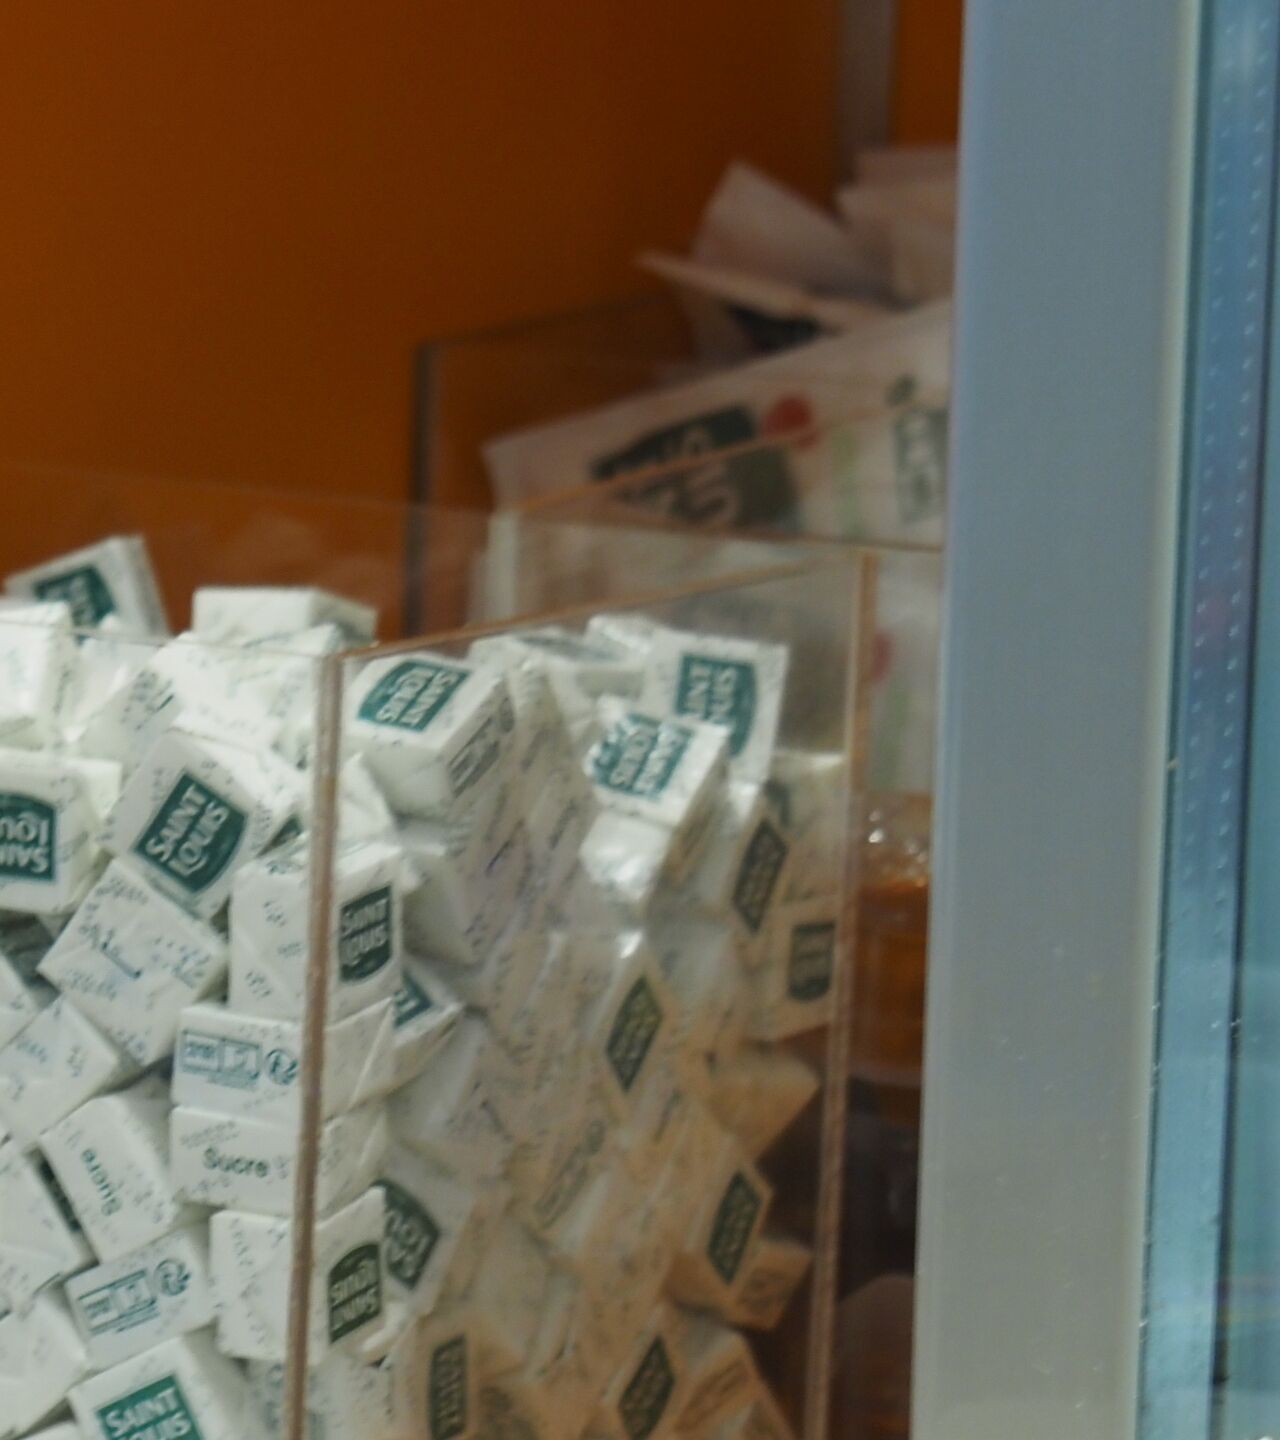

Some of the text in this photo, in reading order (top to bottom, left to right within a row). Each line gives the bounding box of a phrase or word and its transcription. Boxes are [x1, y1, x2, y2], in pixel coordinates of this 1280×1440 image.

[144, 783, 202, 863] SAINT
[167, 800, 230, 878] LOUIS
[81, 1148, 121, 1217] Sucre
[203, 1146, 270, 1179] Sucre
[106, 1388, 179, 1438] SAINT
